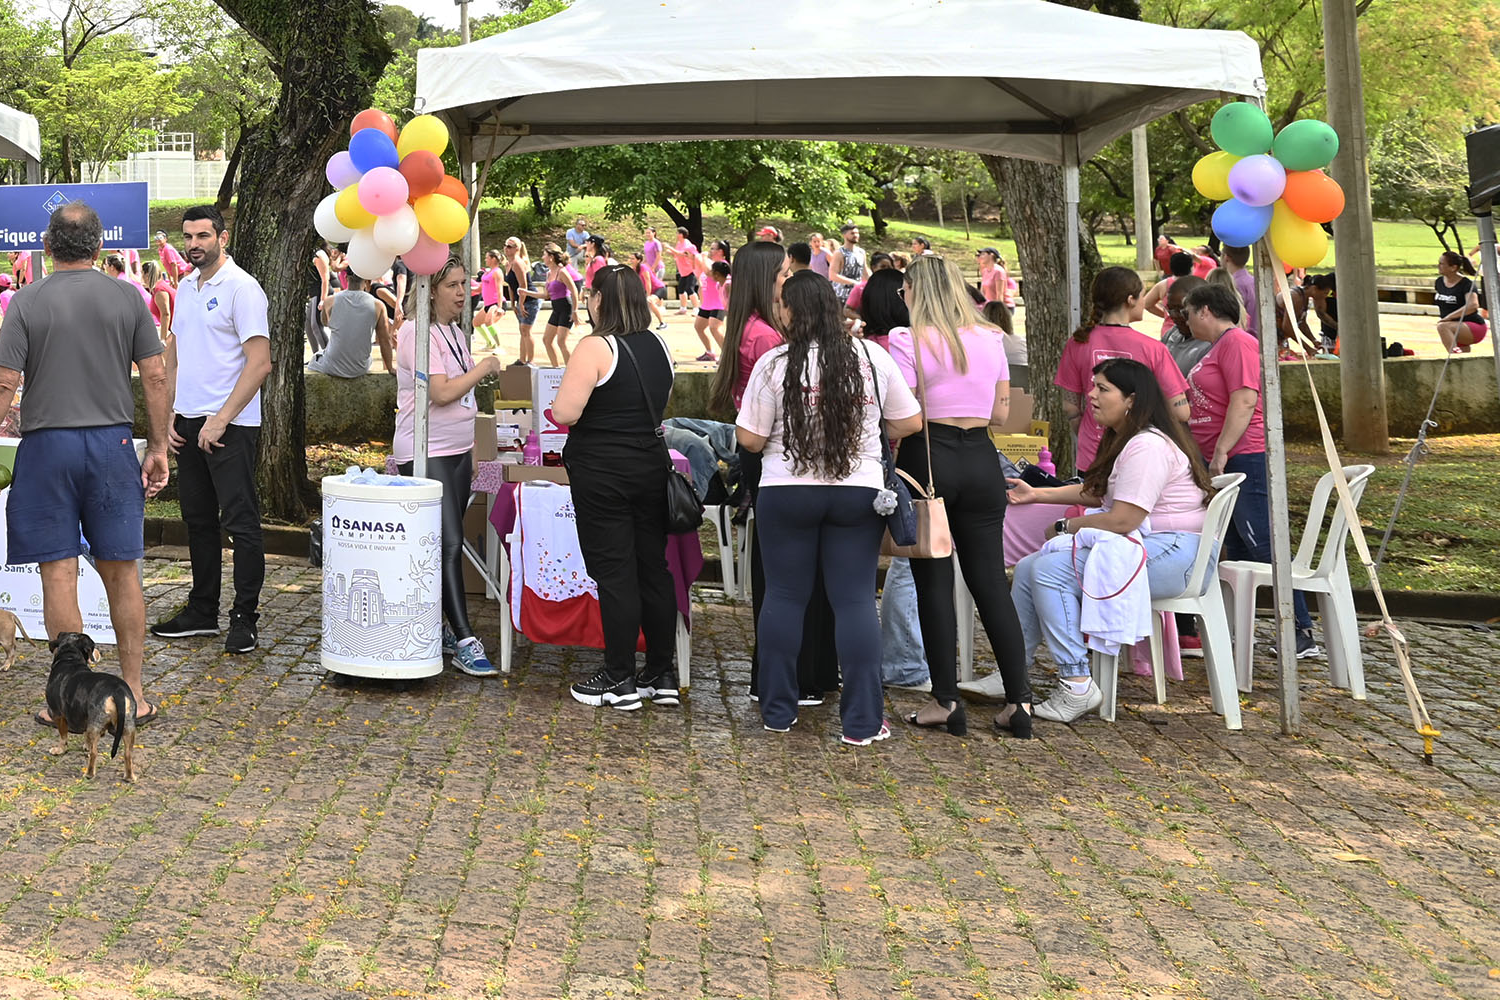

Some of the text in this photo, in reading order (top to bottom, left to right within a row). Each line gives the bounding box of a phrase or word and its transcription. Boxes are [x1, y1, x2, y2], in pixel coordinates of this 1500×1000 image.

[100, 226, 123, 241] ui!
[342, 519, 406, 533] SANASA
[332, 529, 406, 541] CAMPINAS
[4, 563, 33, 574] Sam's
